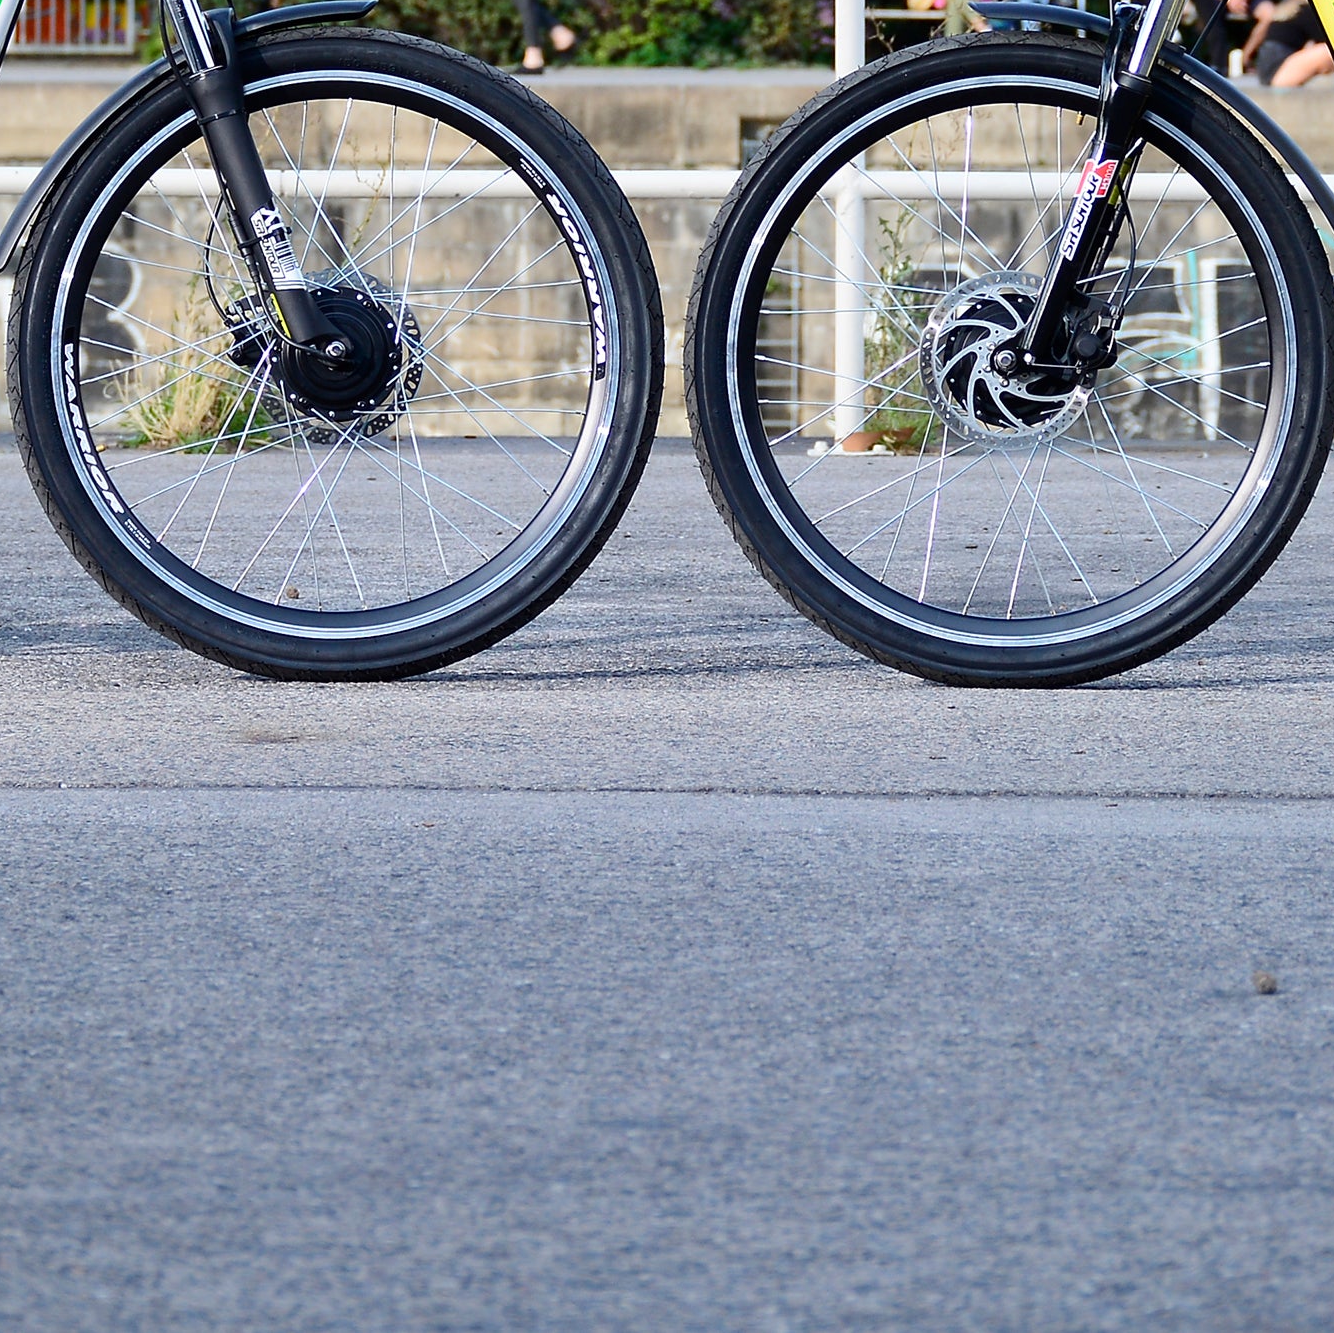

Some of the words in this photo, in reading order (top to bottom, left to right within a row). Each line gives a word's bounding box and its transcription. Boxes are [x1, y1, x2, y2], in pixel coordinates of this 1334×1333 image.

[261, 236, 281, 274] UNTOUR
[546, 193, 606, 365] WARRIOR
[64, 342, 125, 514] WARRIOR
